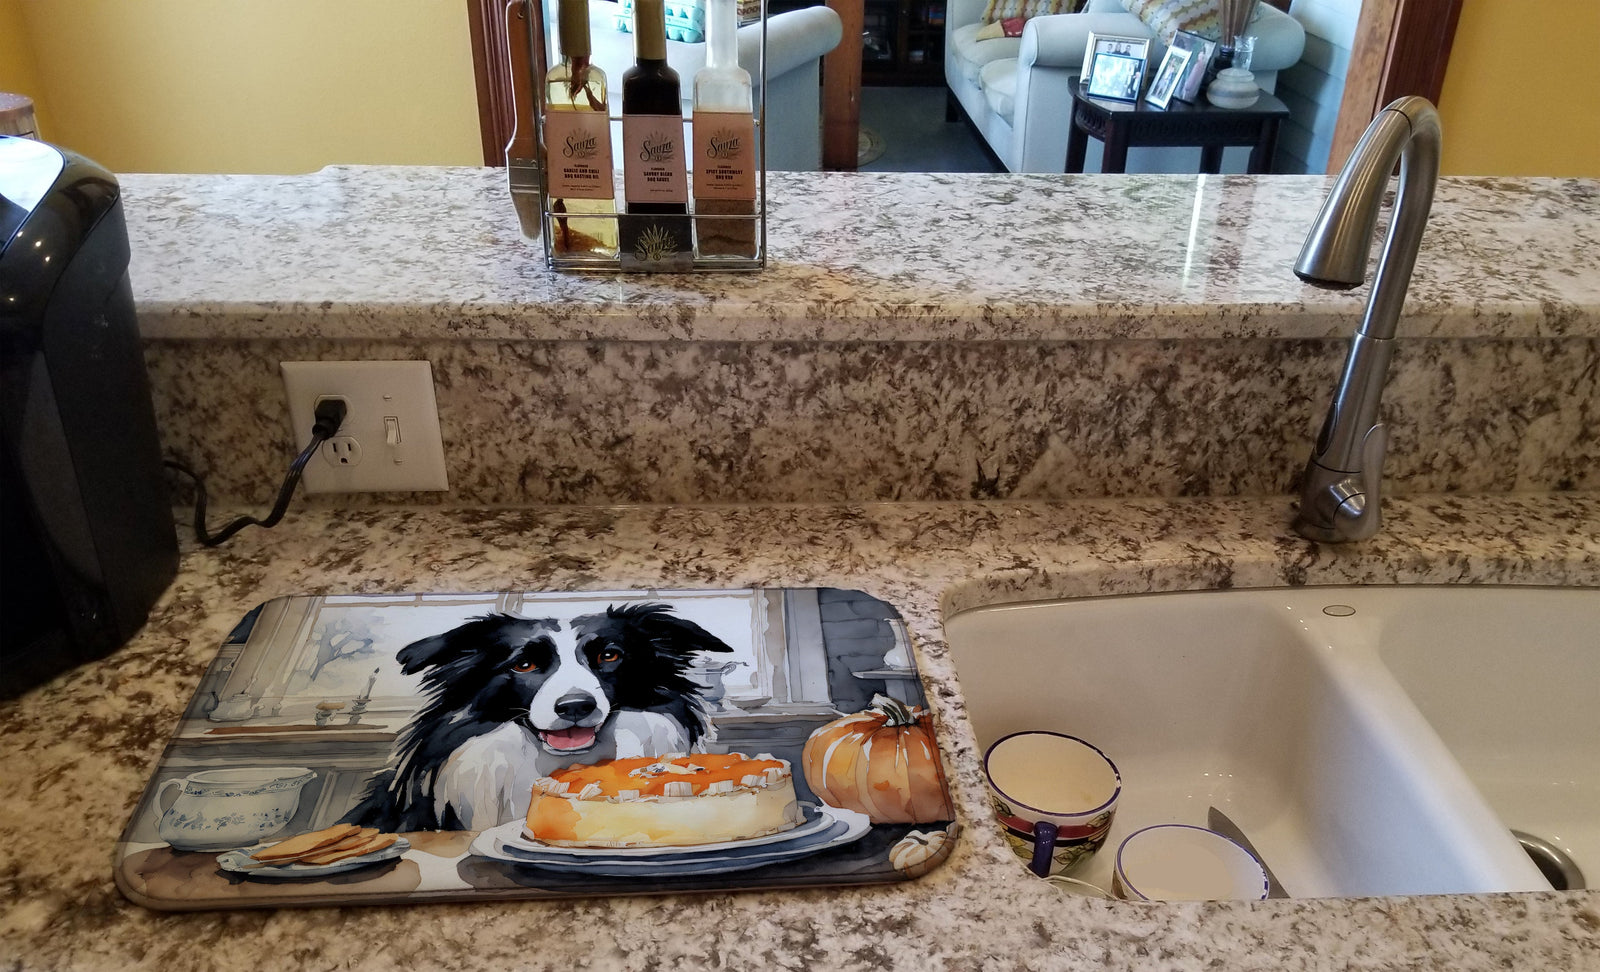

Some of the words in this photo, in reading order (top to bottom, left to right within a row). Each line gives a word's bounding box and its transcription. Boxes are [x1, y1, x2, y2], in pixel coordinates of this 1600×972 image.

[563, 136, 597, 158] Sauza
[640, 140, 673, 161] Sauza
[707, 136, 740, 159] Sauza
